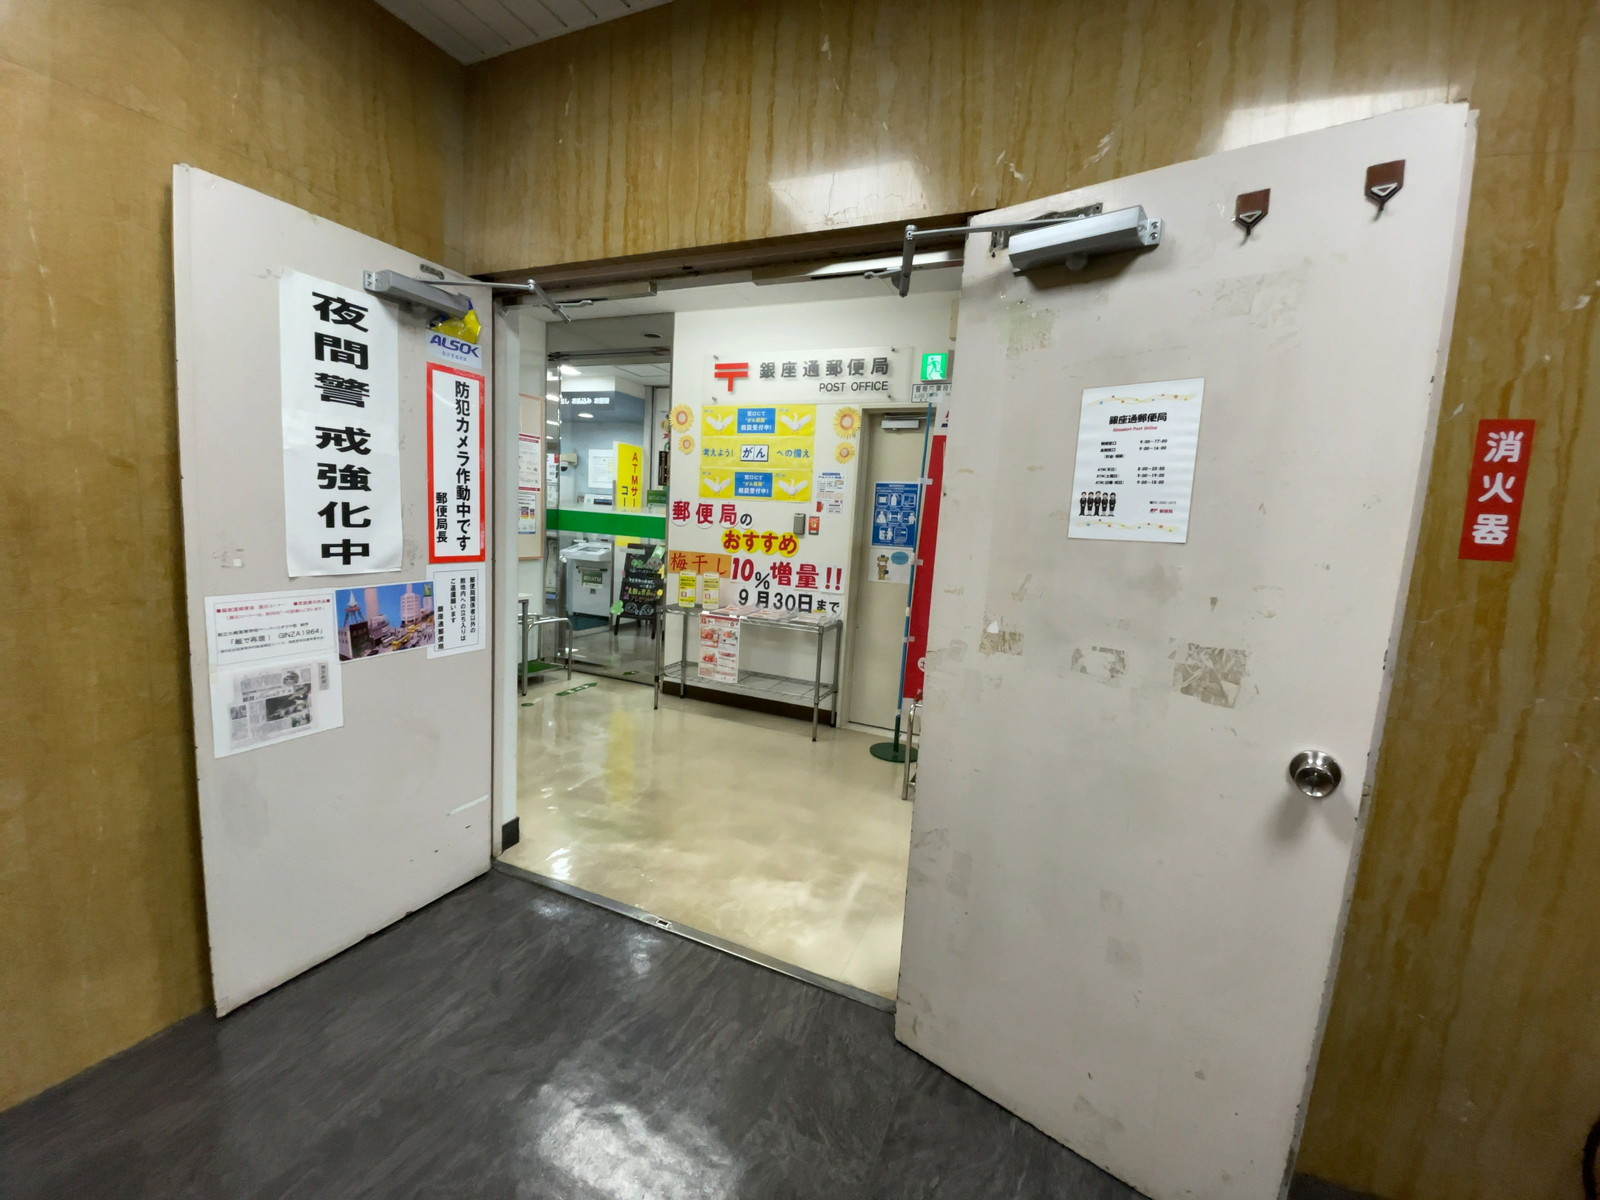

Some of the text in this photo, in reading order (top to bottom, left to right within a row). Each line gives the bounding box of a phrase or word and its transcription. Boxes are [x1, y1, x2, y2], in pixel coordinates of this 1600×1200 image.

[430, 334, 479, 358] ALSOK
[759, 357, 889, 379] 銀座通郵便局
[819, 381, 889, 393] POST OFFICE
[312, 291, 372, 566] 夜間警戒強化中
[1109, 412, 1167, 425] 銀座通郵便局
[742, 446, 766, 459] がん
[454, 380, 471, 551] 防犯カメラ作動中です
[1471, 430, 1524, 545] 消火器
[435, 492, 448, 543] 郵便局長
[672, 501, 753, 526] 郵便局の
[723, 530, 798, 555] おすすめ
[670, 552, 728, 576] 梅干し
[738, 588, 840, 613] 9月30日まで
